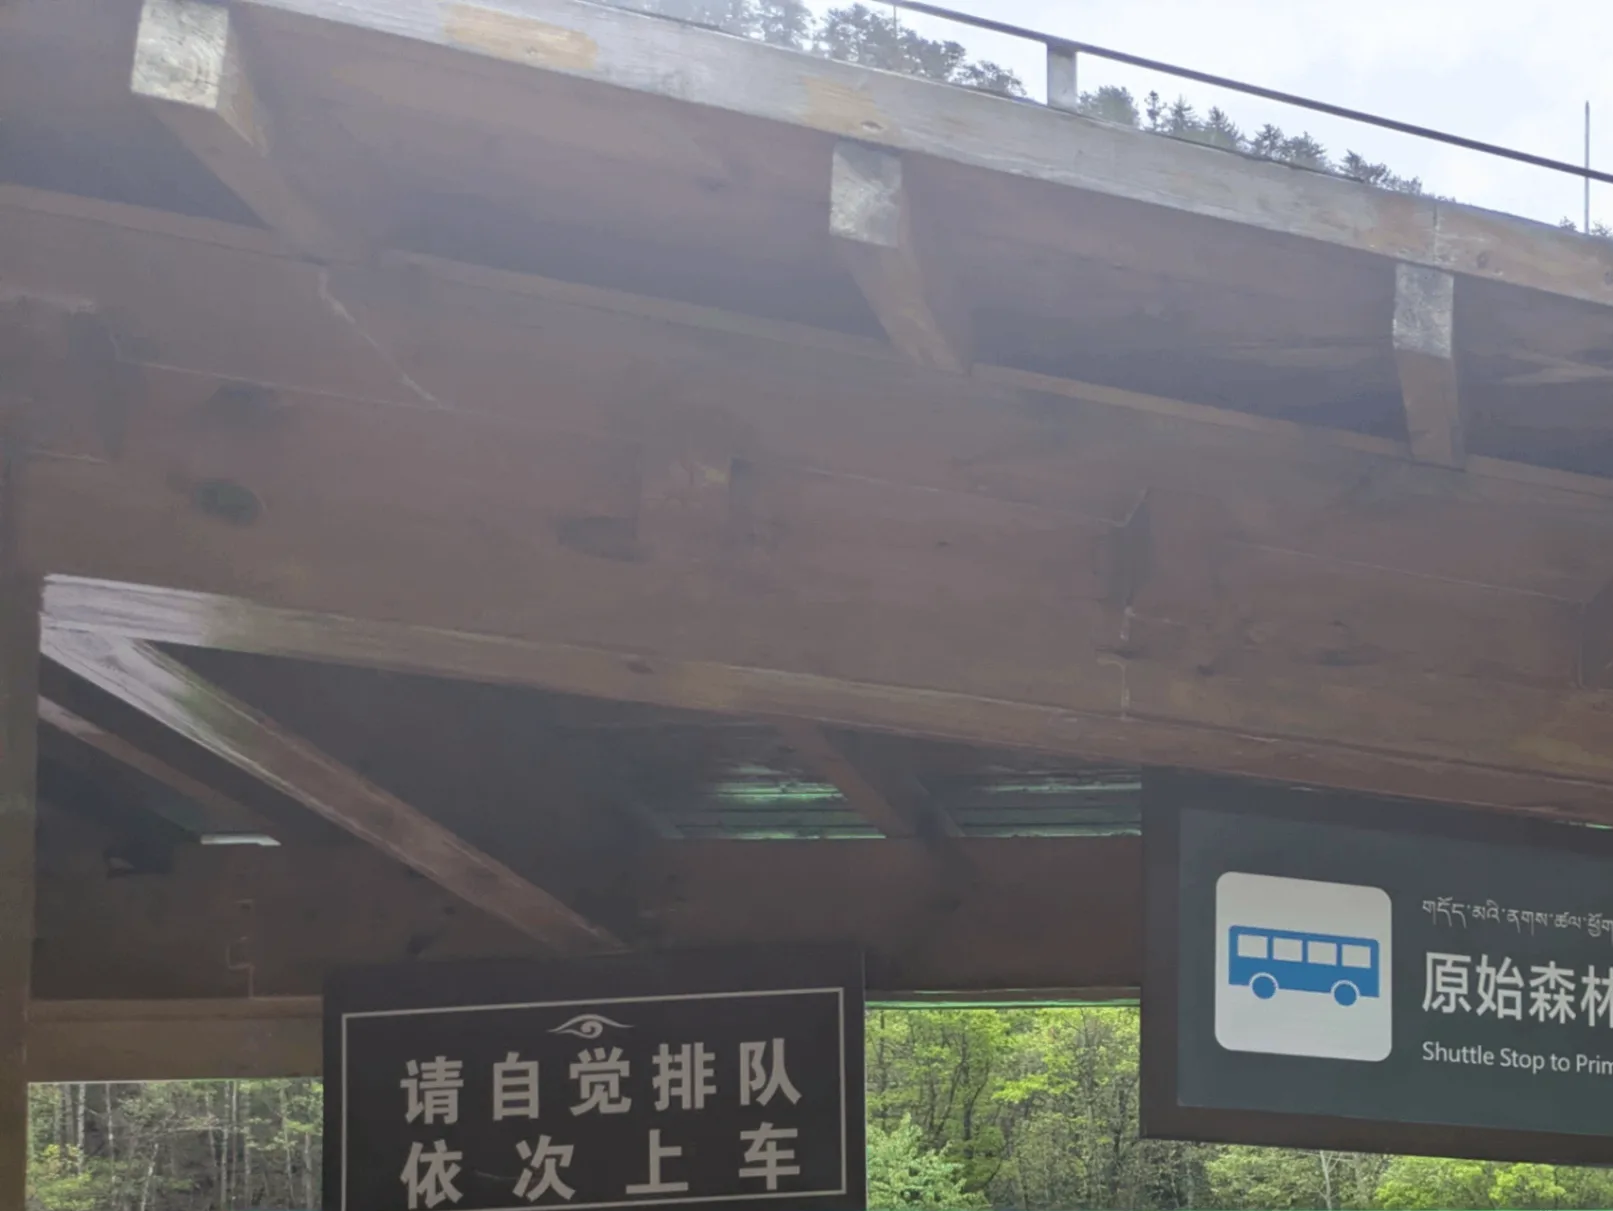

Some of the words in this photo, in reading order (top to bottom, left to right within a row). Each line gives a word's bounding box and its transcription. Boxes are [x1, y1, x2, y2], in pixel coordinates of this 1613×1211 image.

[400, 1037, 802, 1125] 请自觉排队
[1422, 1041, 1495, 1066] Shuttle
[1500, 1047, 1545, 1074] Stop
[1550, 1053, 1570, 1072] to
[400, 1121, 801, 1210] 依次上车
